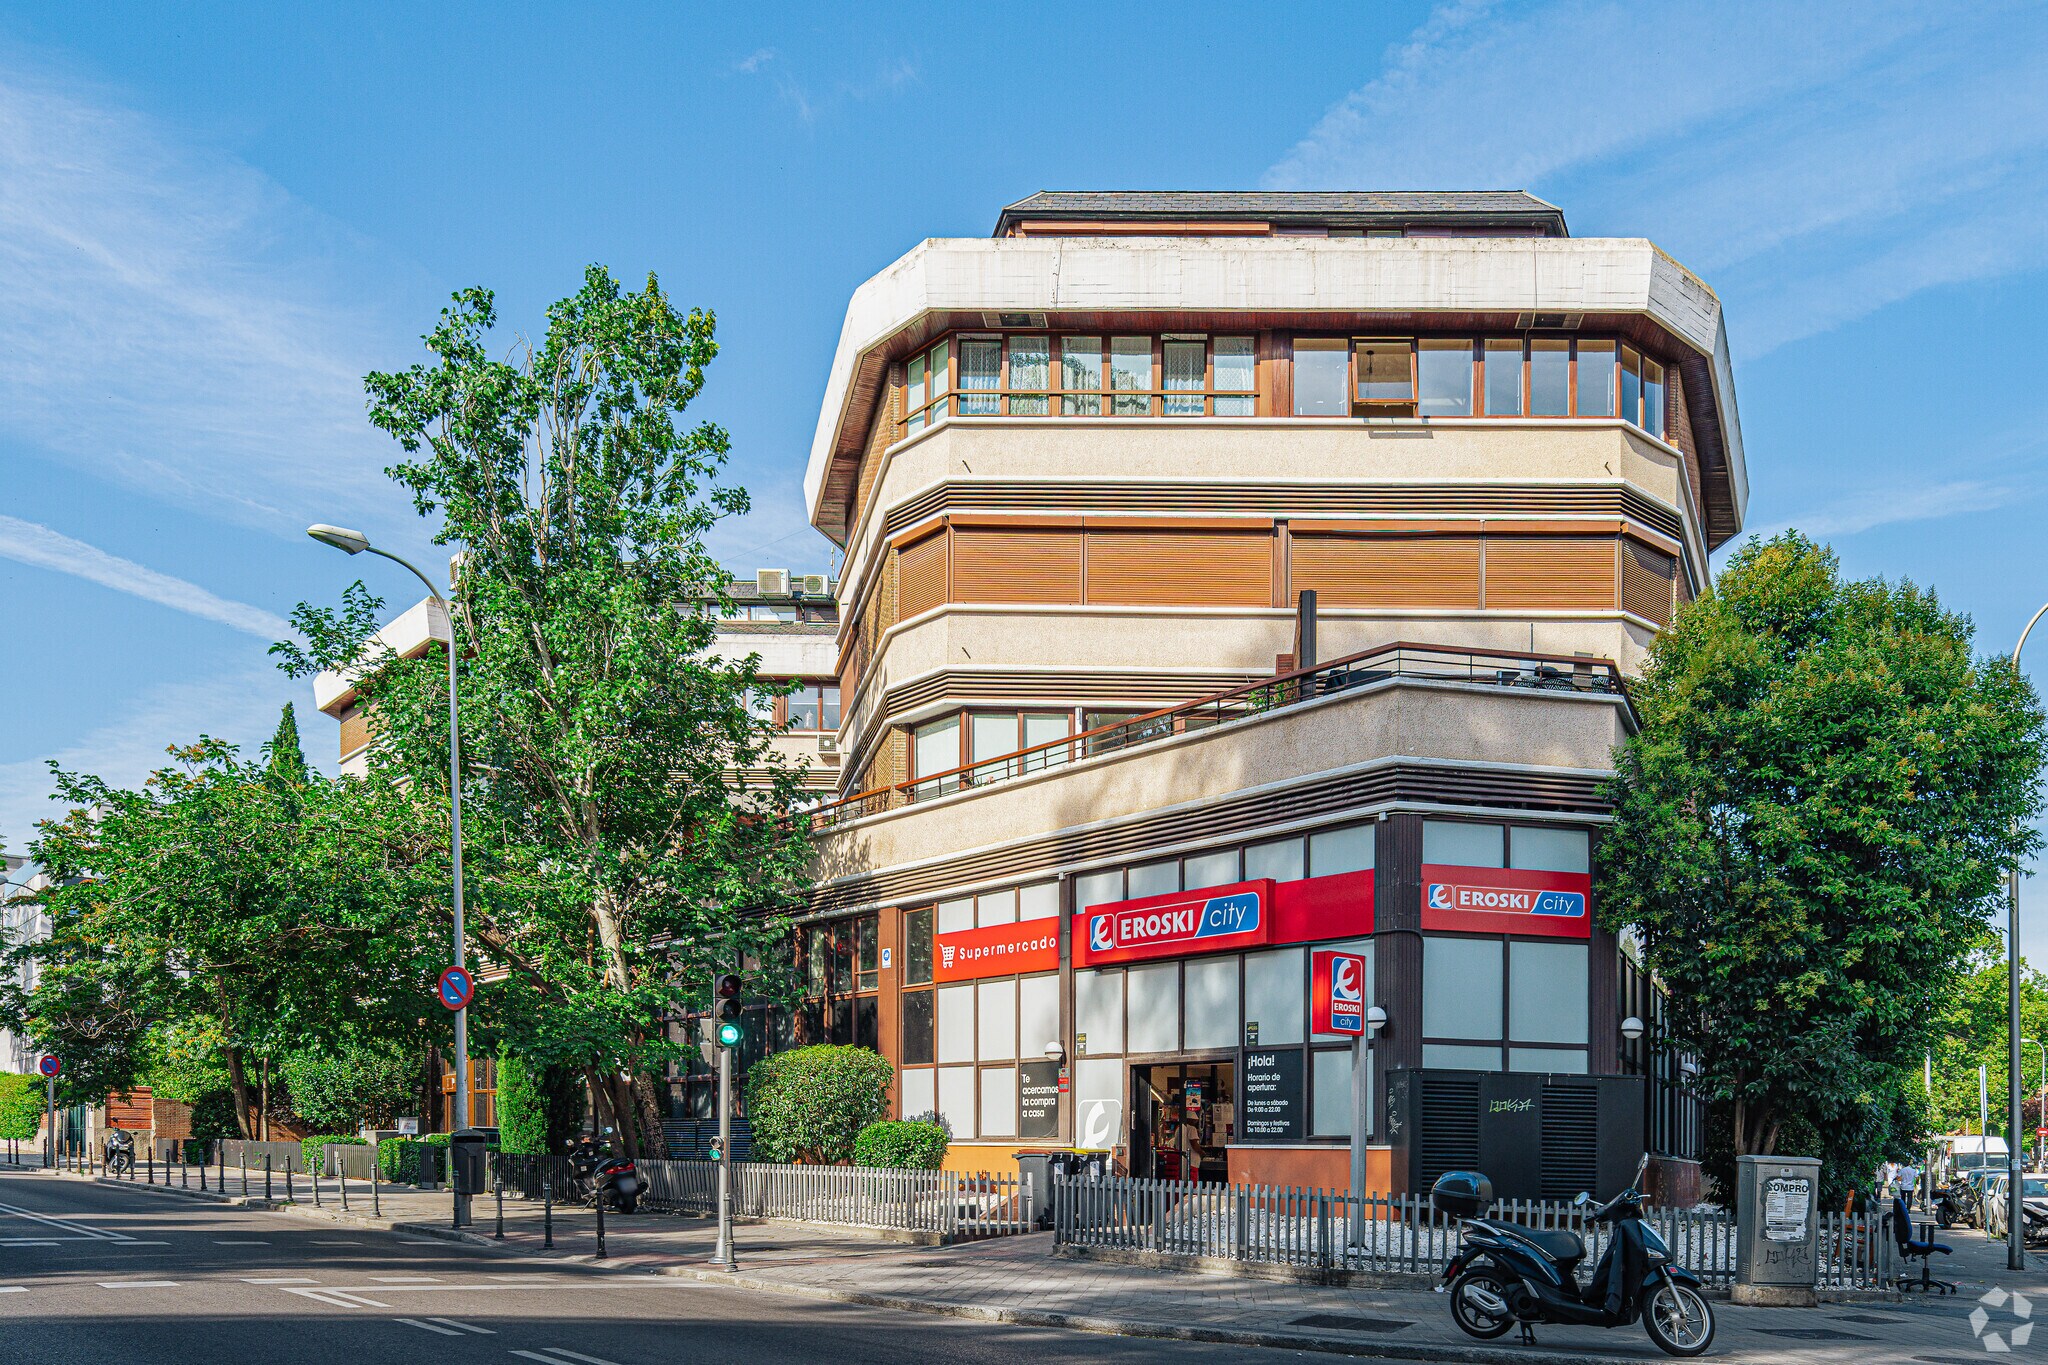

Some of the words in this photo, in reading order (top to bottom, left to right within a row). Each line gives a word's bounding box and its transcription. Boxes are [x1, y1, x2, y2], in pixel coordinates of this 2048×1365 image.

[1460, 890, 1529, 909] EROSKI
[1543, 895, 1574, 914] city
[1121, 909, 1193, 940] EROSKI
[1210, 902, 1246, 929] city
[959, 936, 1056, 960] Supermercado
[1334, 1002, 1360, 1013] EROSKI
[1340, 1016, 1353, 1028] city
[1248, 1055, 1275, 1069] ¡Hola!
[1022, 1074, 1030, 1083] Te
[1247, 1073, 1271, 1081] Horario
[1022, 1086, 1058, 1094] acercamos
[1247, 1083, 1276, 1092] apertura:
[1022, 1097, 1029, 1106] la
[1030, 1098, 1055, 1107] compra
